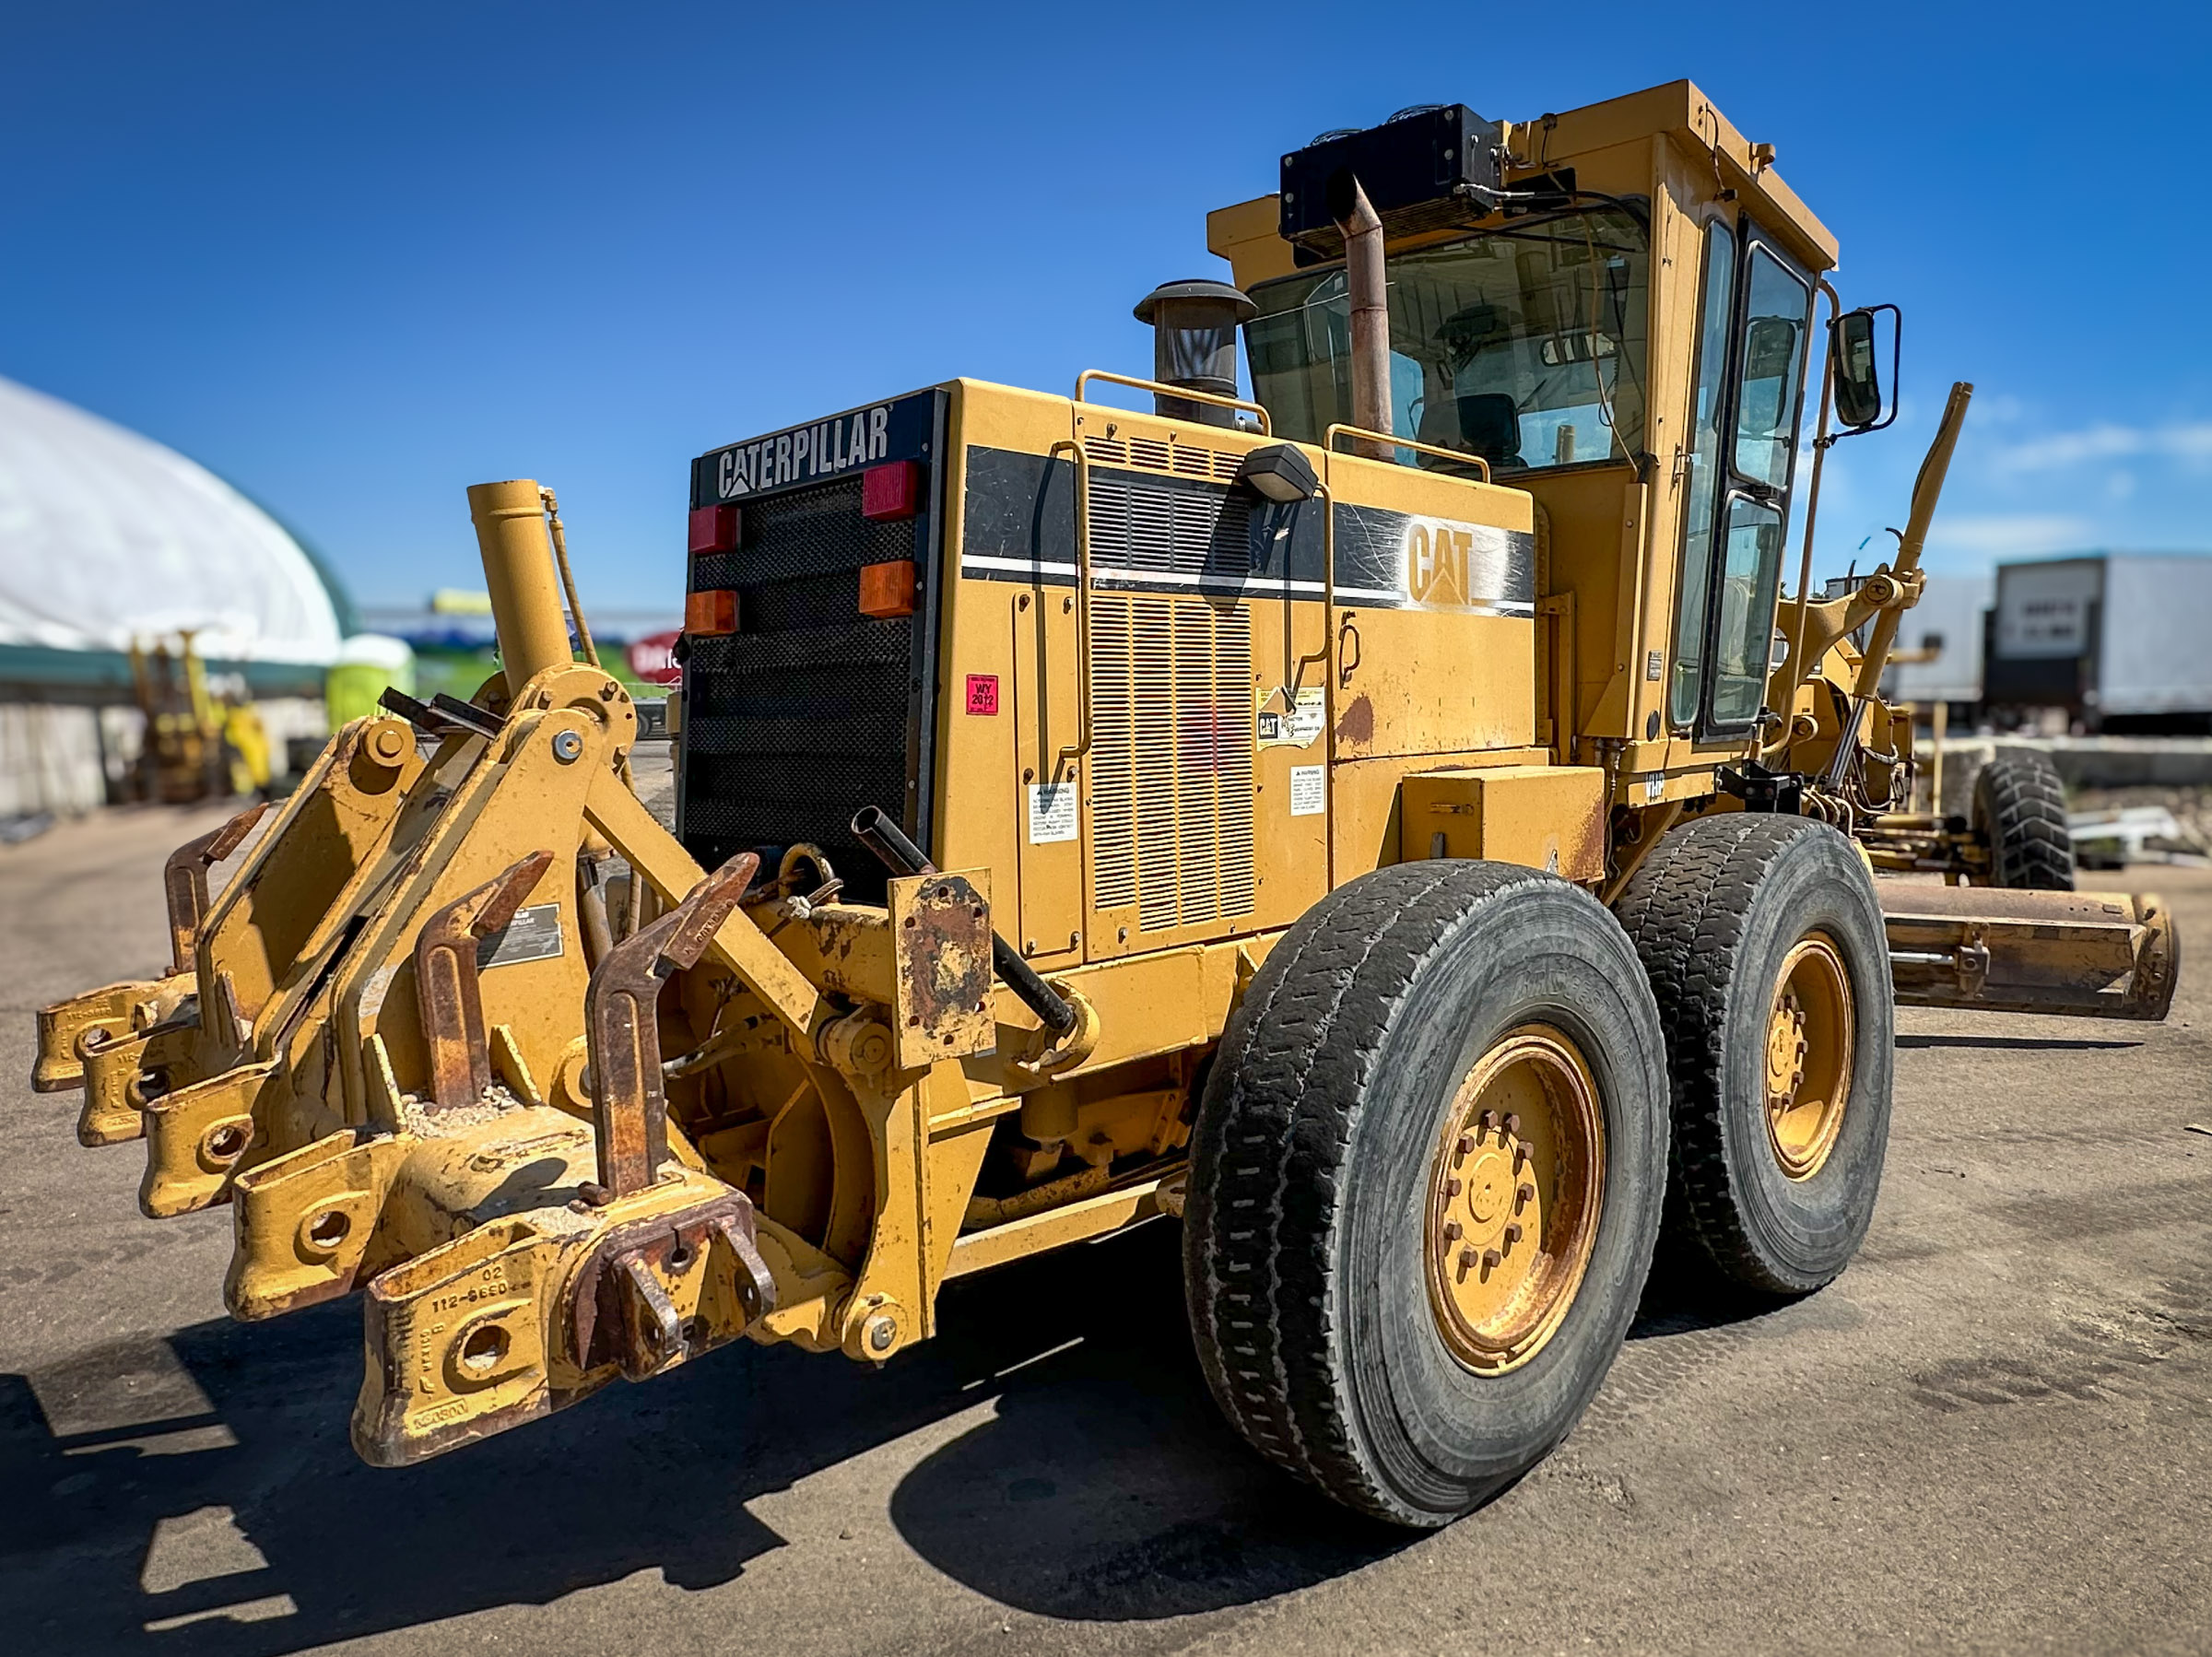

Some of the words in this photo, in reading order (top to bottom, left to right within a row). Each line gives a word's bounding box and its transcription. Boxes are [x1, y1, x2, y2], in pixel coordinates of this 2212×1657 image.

[718, 406, 888, 499] CATERPILLAR
[1408, 523, 1473, 605] CAT
[975, 683, 992, 694] WY
[1259, 717, 1277, 736] CAT
[482, 1265, 503, 1281] 02
